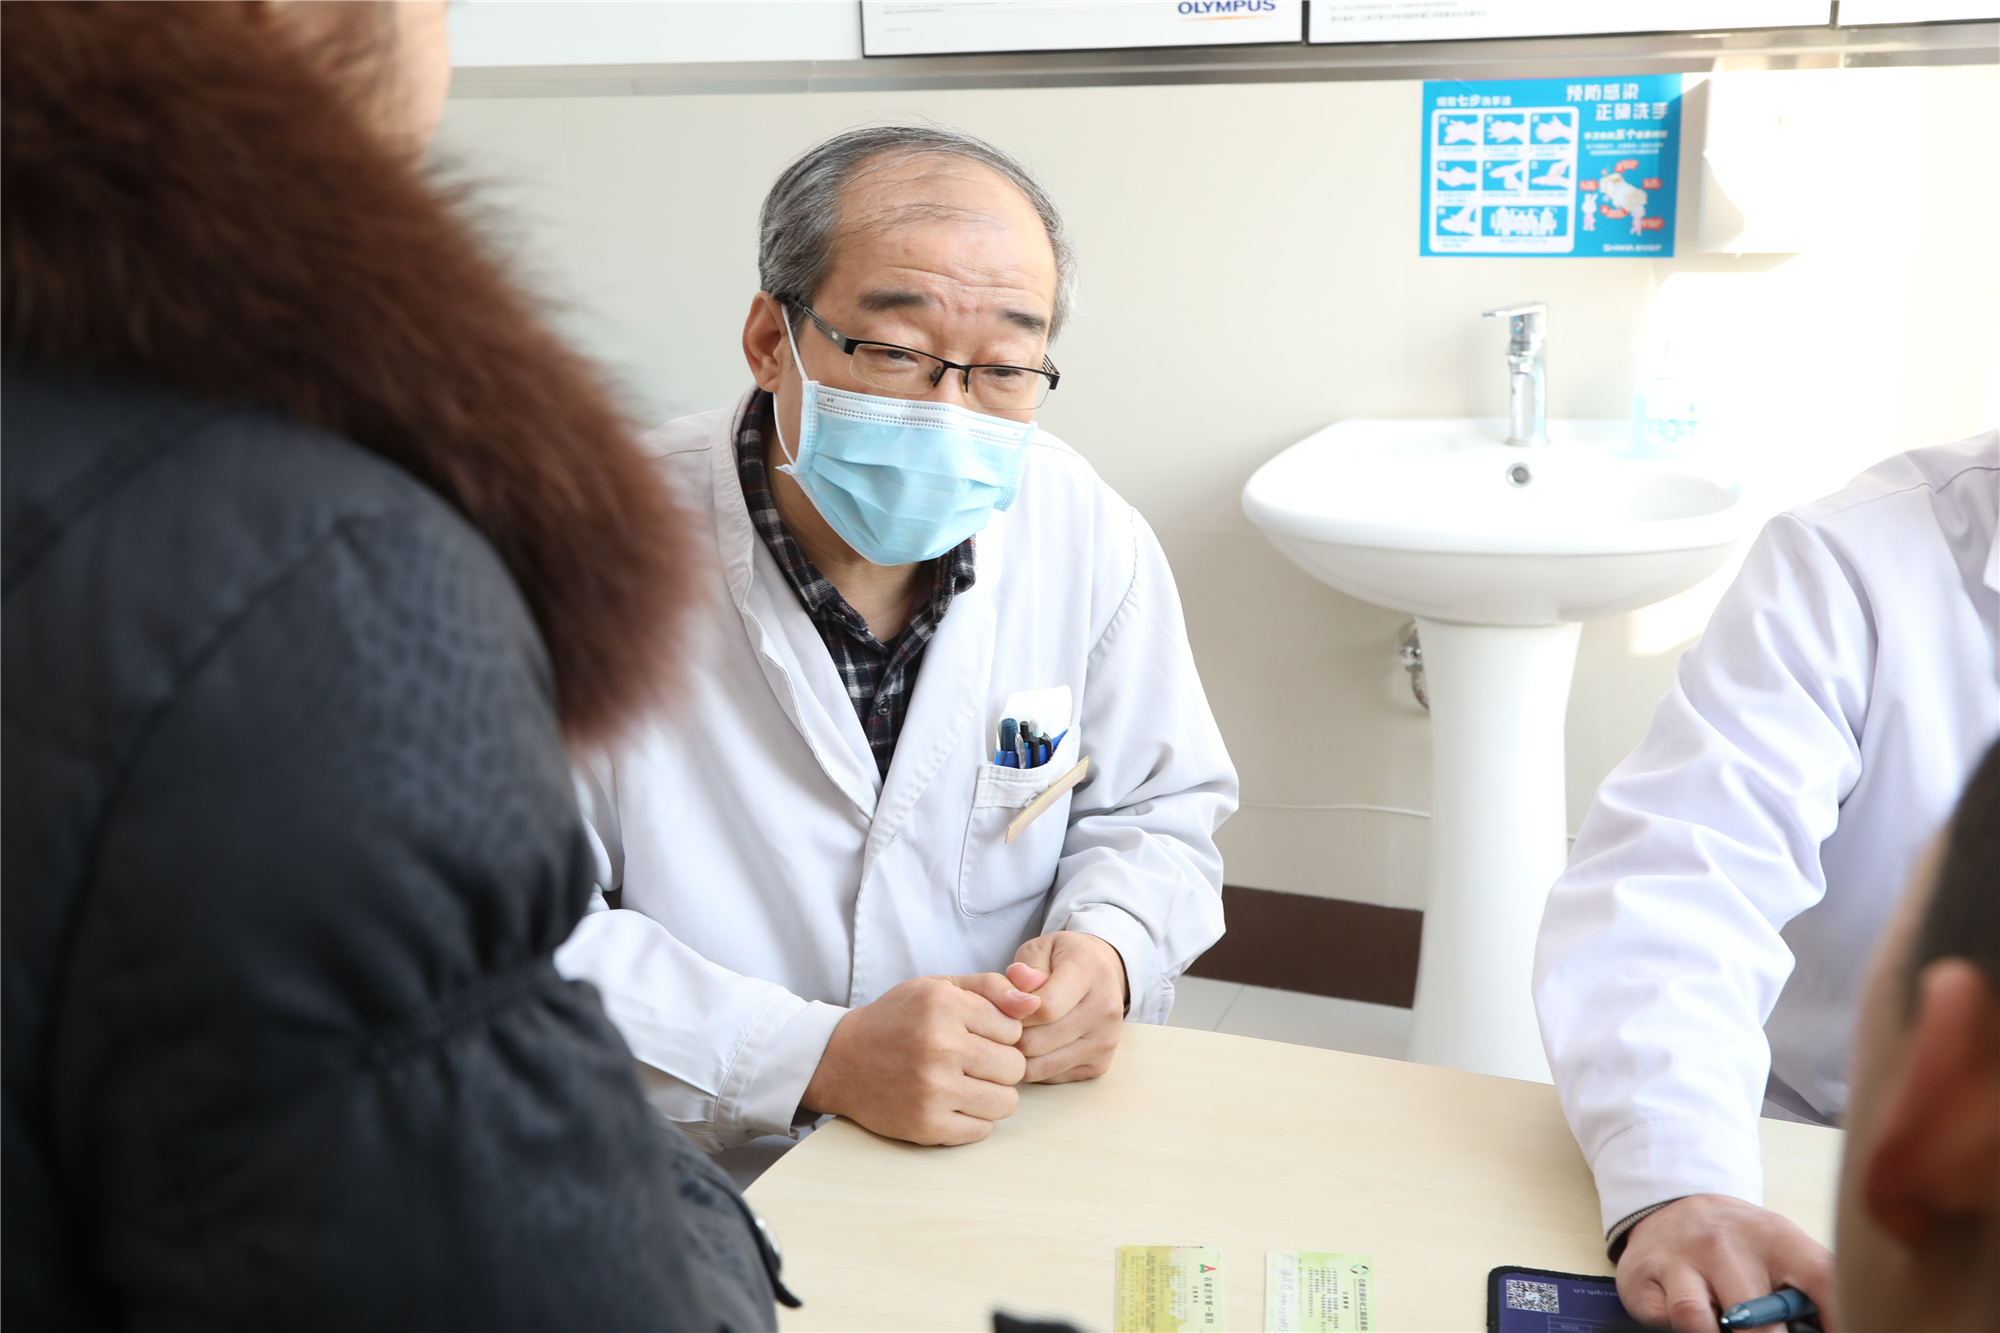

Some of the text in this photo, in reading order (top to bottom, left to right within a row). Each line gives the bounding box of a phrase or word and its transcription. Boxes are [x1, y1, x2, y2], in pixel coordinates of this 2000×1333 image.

[1178, 0, 1276, 14] OLYMPUS
[1566, 83, 1640, 102] 预防感染
[1595, 102, 1669, 121] 正确洗手
[1204, 1277, 1214, 1325] 石家庄市第一医院
